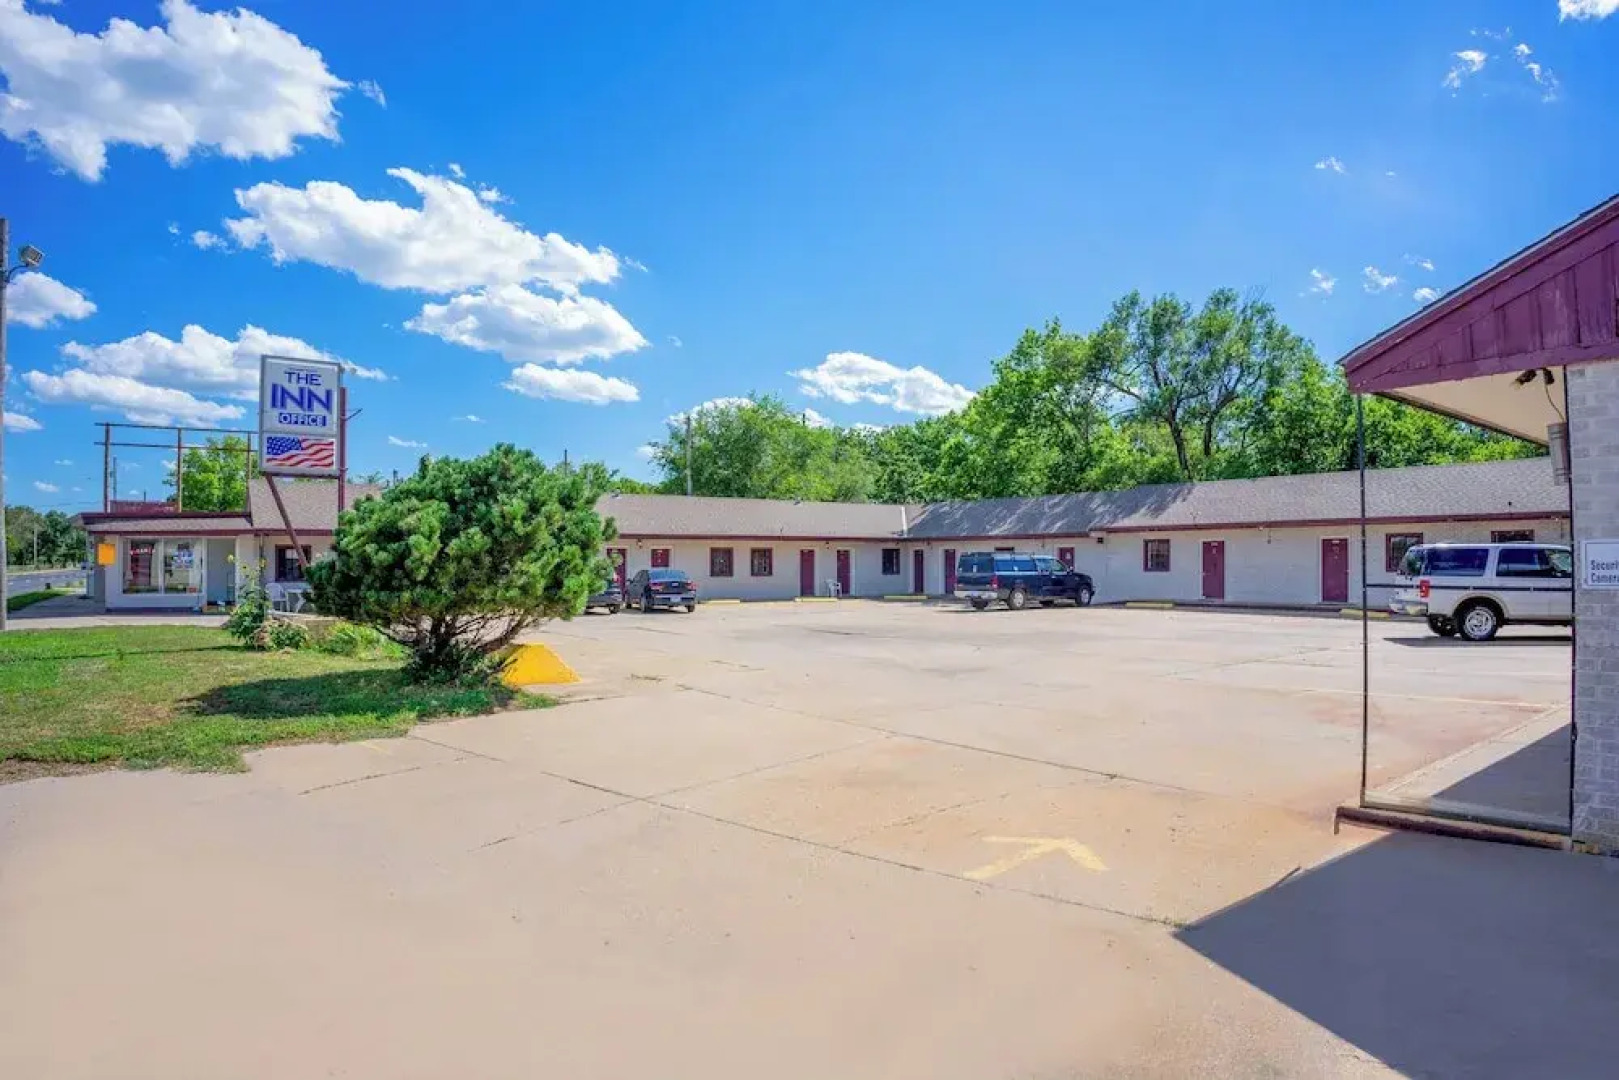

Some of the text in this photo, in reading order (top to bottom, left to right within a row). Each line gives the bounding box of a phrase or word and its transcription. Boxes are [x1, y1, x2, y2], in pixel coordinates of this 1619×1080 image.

[284, 371, 322, 386] THE
[271, 383, 333, 414] INN
[280, 414, 325, 426] OFFICE
[1591, 559, 1619, 571] Securi
